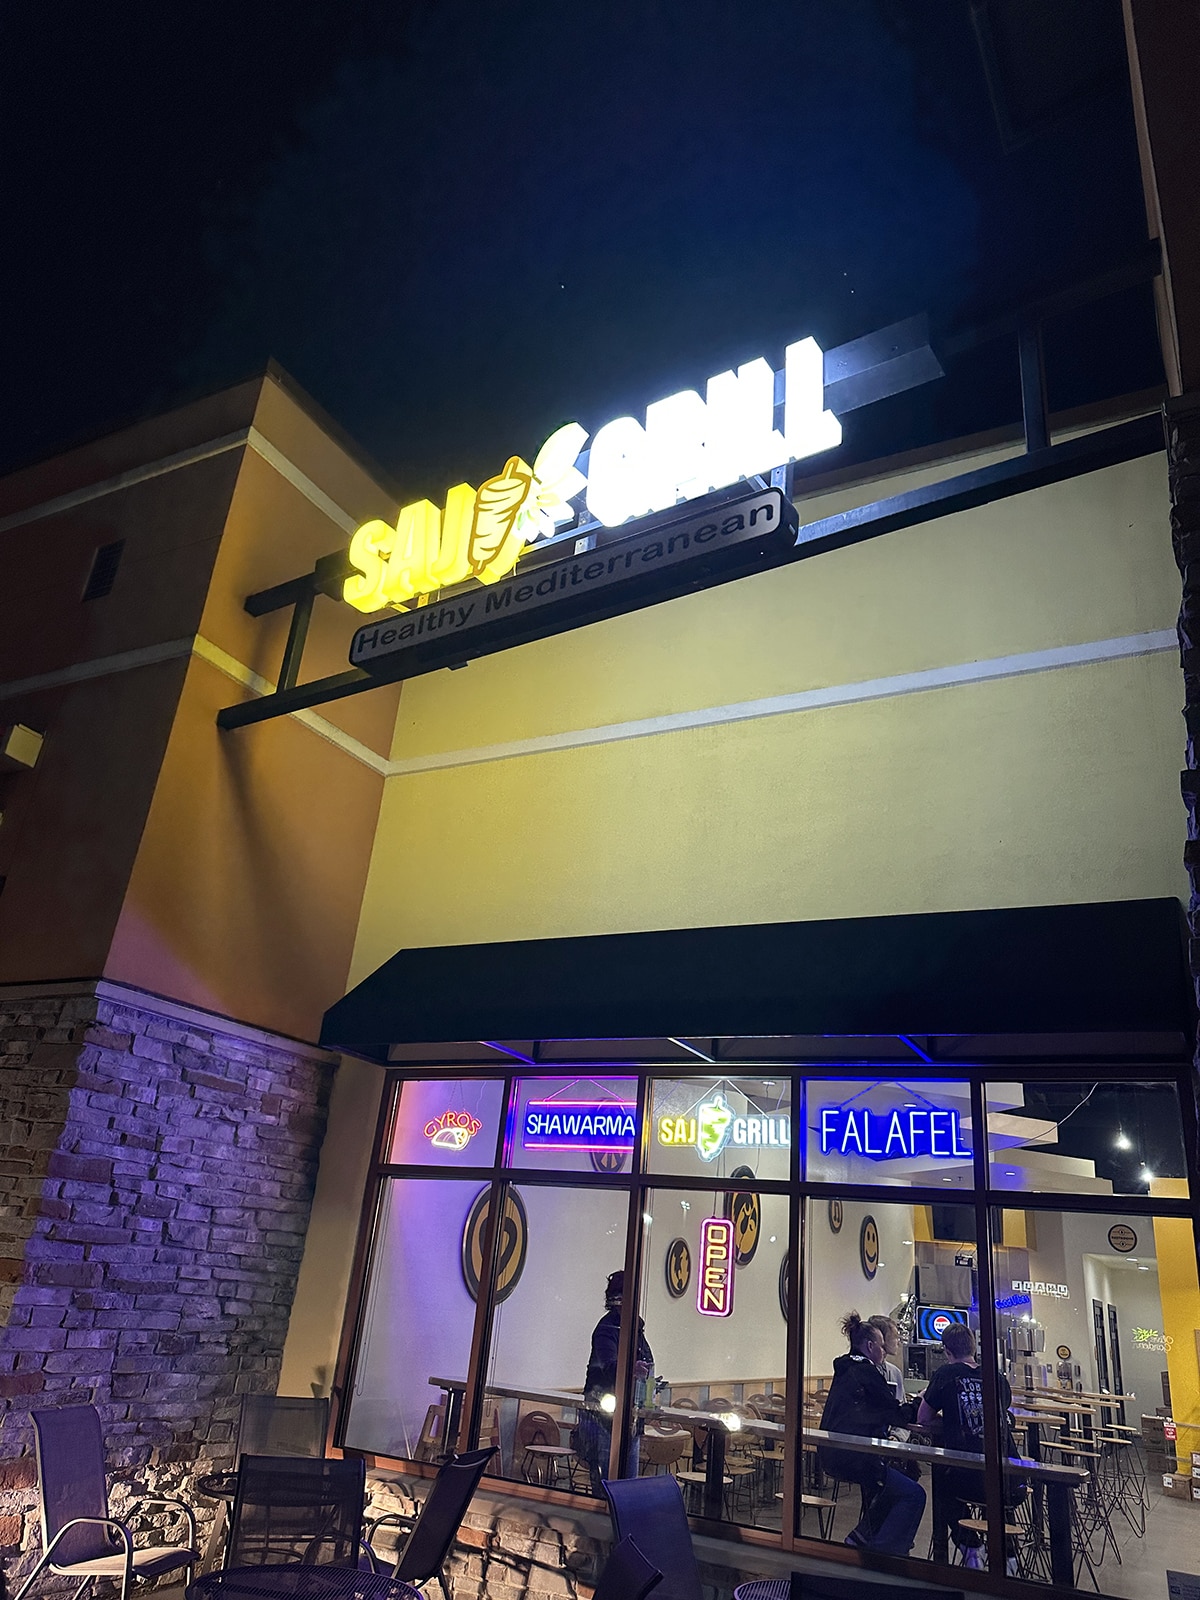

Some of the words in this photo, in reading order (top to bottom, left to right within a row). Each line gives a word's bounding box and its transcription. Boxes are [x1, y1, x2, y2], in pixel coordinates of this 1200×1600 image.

[343, 482, 478, 614] SAJ
[357, 602, 476, 653] Healthy
[485, 502, 775, 613] Mediterranean
[423, 1110, 481, 1139] GYROS
[526, 1114, 636, 1137] SHAWARMA
[661, 1117, 696, 1144] SAJ
[733, 1119, 791, 1145] GRILL
[821, 1110, 973, 1156] FALAFEL
[703, 1225, 728, 1311] OPEN
